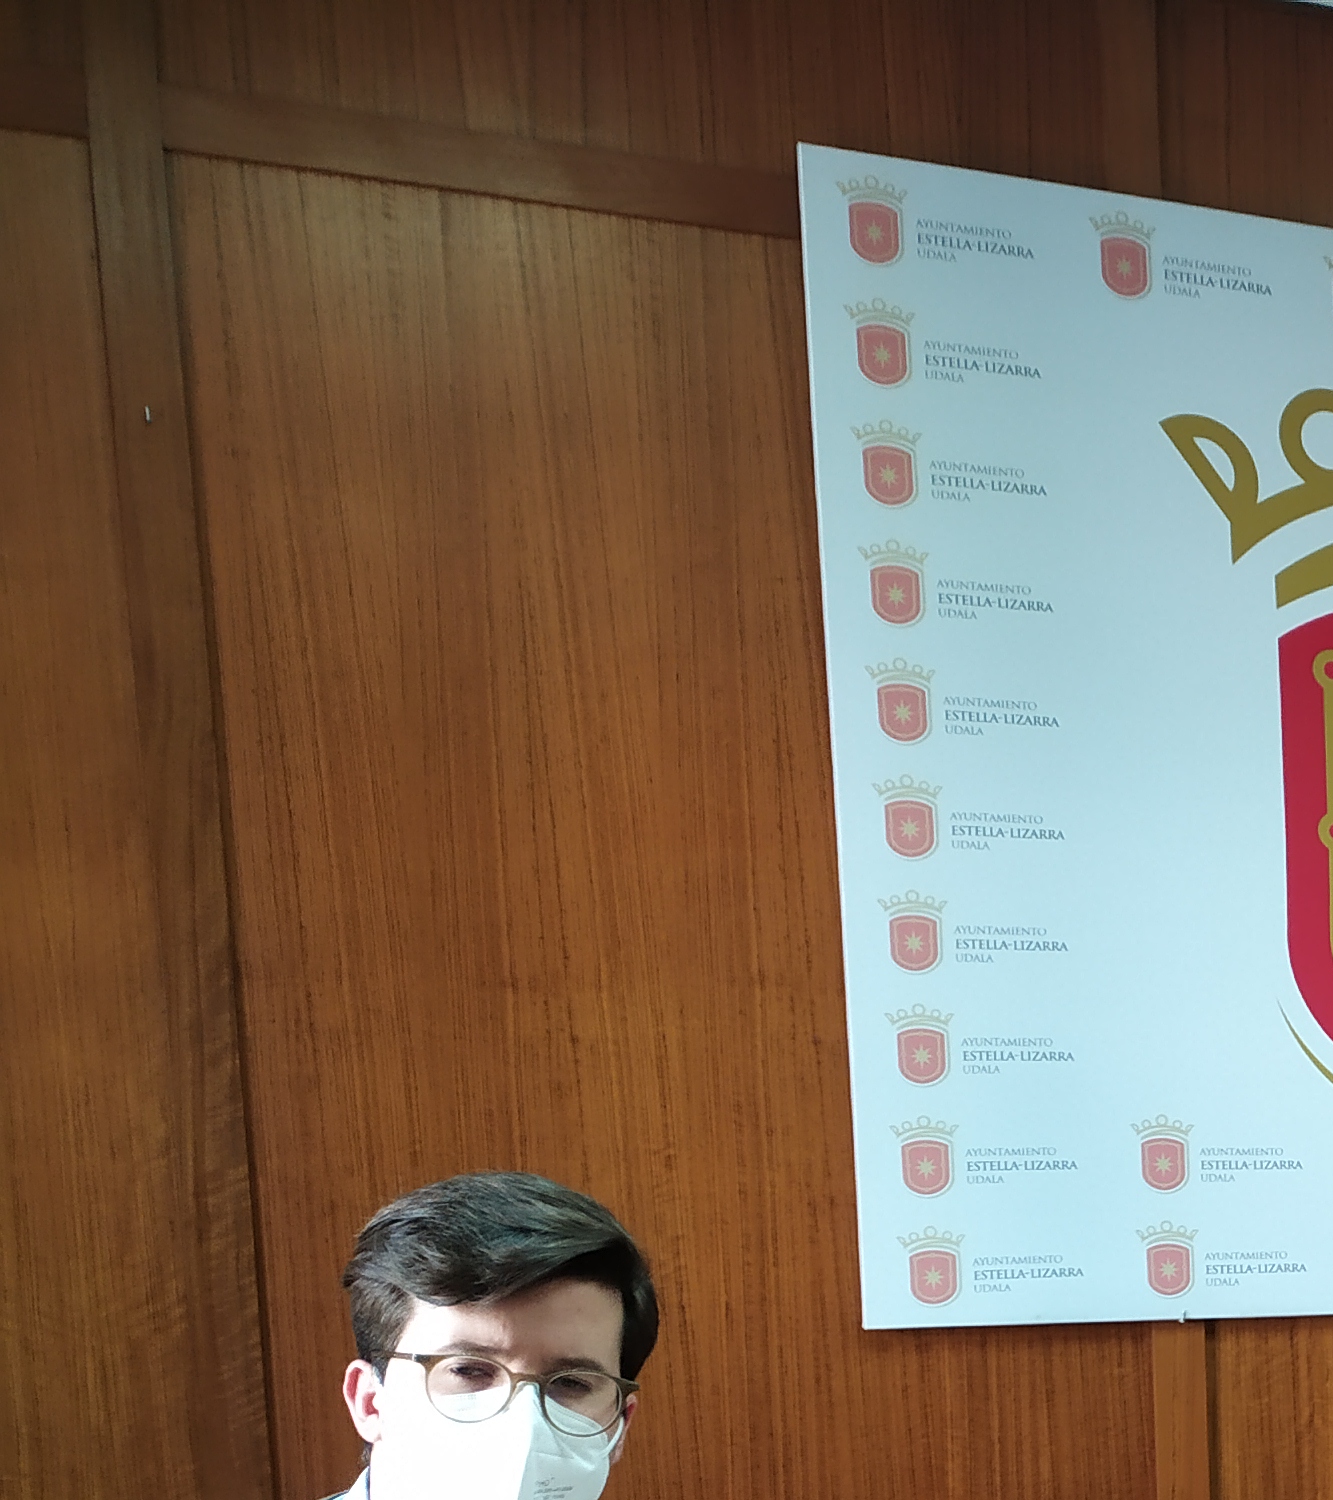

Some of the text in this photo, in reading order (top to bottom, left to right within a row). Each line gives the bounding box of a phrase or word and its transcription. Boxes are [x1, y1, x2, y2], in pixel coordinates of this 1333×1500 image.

[915, 218, 1012, 240] AYUNTAMIENTO
[917, 232, 1034, 260] ESTELLA-LIZARRA
[916, 246, 957, 263] UDALA
[1161, 255, 1252, 278] AYUNTAMIENTO
[1164, 268, 1273, 296] ESTELLA-LIZARRA
[1163, 282, 1201, 299] UDALA
[923, 340, 1019, 360] AYUNTAMIENTO
[924, 353, 1042, 379] ESTELLA-LIZARRA
[924, 369, 965, 384] UDALA
[929, 459, 1025, 480] AYUNTAMIENTO
[930, 473, 1048, 497] ESTELLA-LIZARRA
[930, 489, 971, 502] UDALA
[936, 579, 1032, 596] AYUNTAMIENTO
[937, 592, 1054, 614] ESTELLA-LIZARRA
[937, 607, 978, 620] UDALA
[943, 696, 1038, 711] AYUNTAMIENTO
[944, 709, 1060, 728] ESTELLA-LIZARRA
[944, 724, 984, 736] UDALA
[949, 811, 1044, 825] AYUNTAMIENTO
[951, 824, 1066, 841] ESTELLA-LIZARRA
[951, 839, 991, 851] UDALA
[953, 925, 1047, 937] AYUNTAMIENTO
[955, 938, 1069, 952] ESTELLA-LIZARRA
[955, 952, 994, 964] UDALA
[960, 1037, 1054, 1048] AYUNTAMIENTO
[962, 1049, 1075, 1062] ESTELLA-LIZARRA
[962, 1064, 1001, 1075] UDALA
[964, 1146, 1057, 1158] AYUNTAMIENTO
[1199, 1147, 1284, 1157] AYUNTAMIENTO
[966, 1159, 1079, 1172] ESTELLA-LIZARRA
[1200, 1159, 1304, 1171] ESTELLA-LIZARRA
[966, 1174, 1005, 1185] UDALA
[1200, 1173, 1236, 1183] UDALA
[972, 1254, 1064, 1267] AYUNTAMIENTO
[1204, 1250, 1288, 1261] AYUNTAMIENTO
[973, 1267, 1085, 1281] ESTELLA-LIZARRA
[1205, 1262, 1307, 1275] ESTELLA-LIZARRA
[973, 1283, 1012, 1294] UDALA
[1205, 1277, 1240, 1287] UDALA
